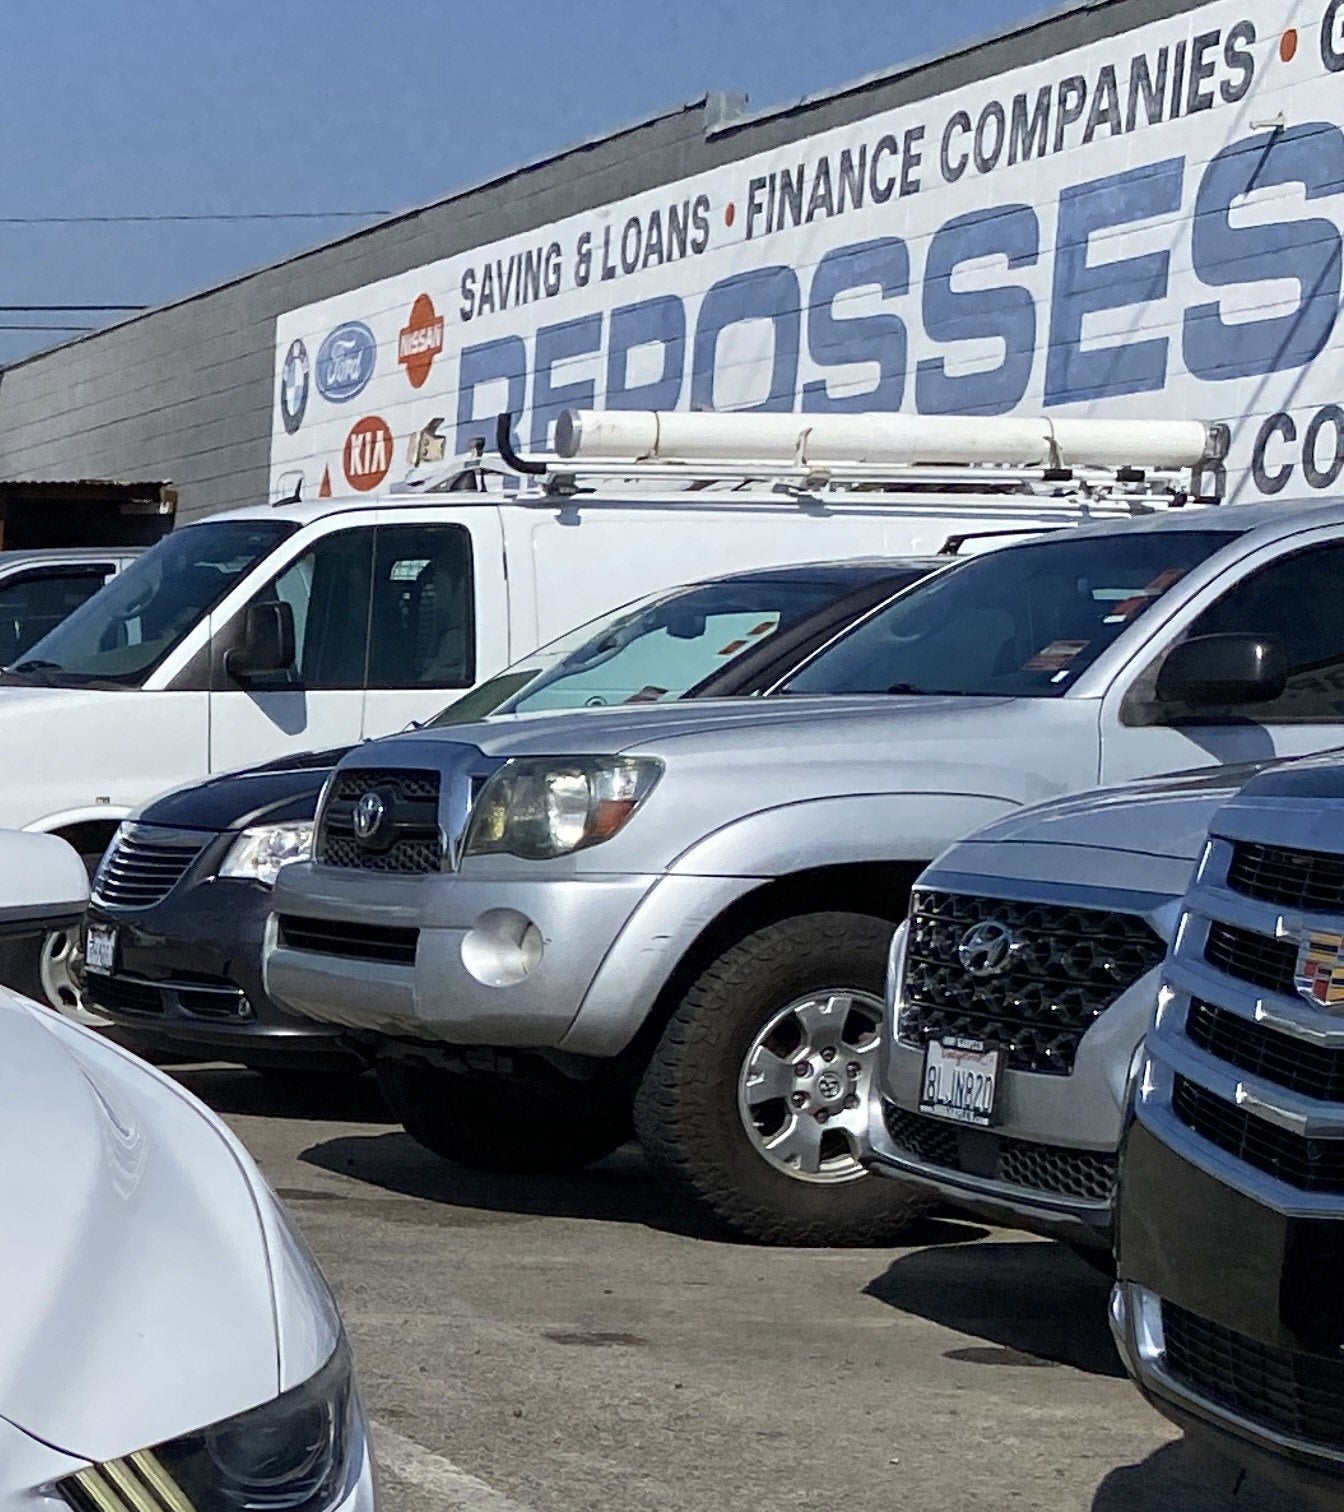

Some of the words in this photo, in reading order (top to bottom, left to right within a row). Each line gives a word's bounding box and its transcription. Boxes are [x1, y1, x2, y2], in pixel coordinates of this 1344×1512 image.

[459, 241, 562, 322] SAVING
[574, 231, 592, 288] &
[601, 194, 711, 282] LOANS
[745, 124, 926, 241] FINANCE
[940, 19, 1257, 184] COMPANIES
[349, 429, 388, 476] KIA
